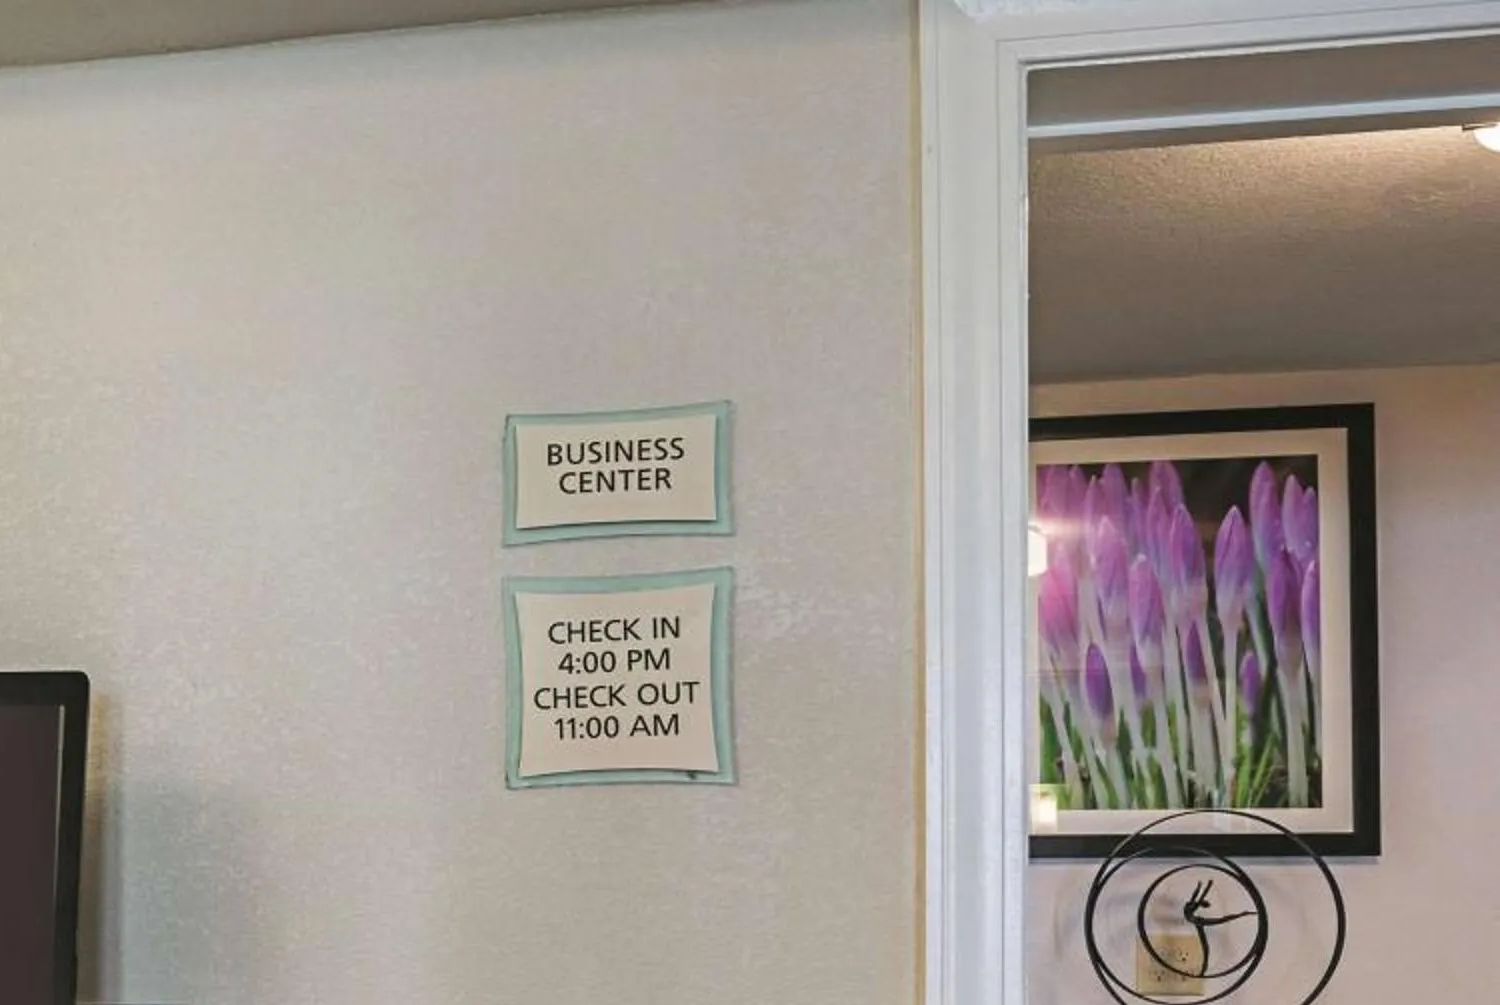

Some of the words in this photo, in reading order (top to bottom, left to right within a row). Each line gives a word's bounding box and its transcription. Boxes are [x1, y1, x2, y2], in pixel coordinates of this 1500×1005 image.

[547, 437, 685, 466] BUSINESS
[558, 468, 672, 495] CENTER
[547, 617, 642, 644] CHECK
[652, 616, 681, 640] IN
[558, 651, 617, 675] 4:00
[627, 648, 671, 672] PM
[533, 684, 626, 711] CHECK
[637, 681, 700, 706] OUT
[554, 716, 620, 741] 11:00
[629, 713, 680, 737] AM
